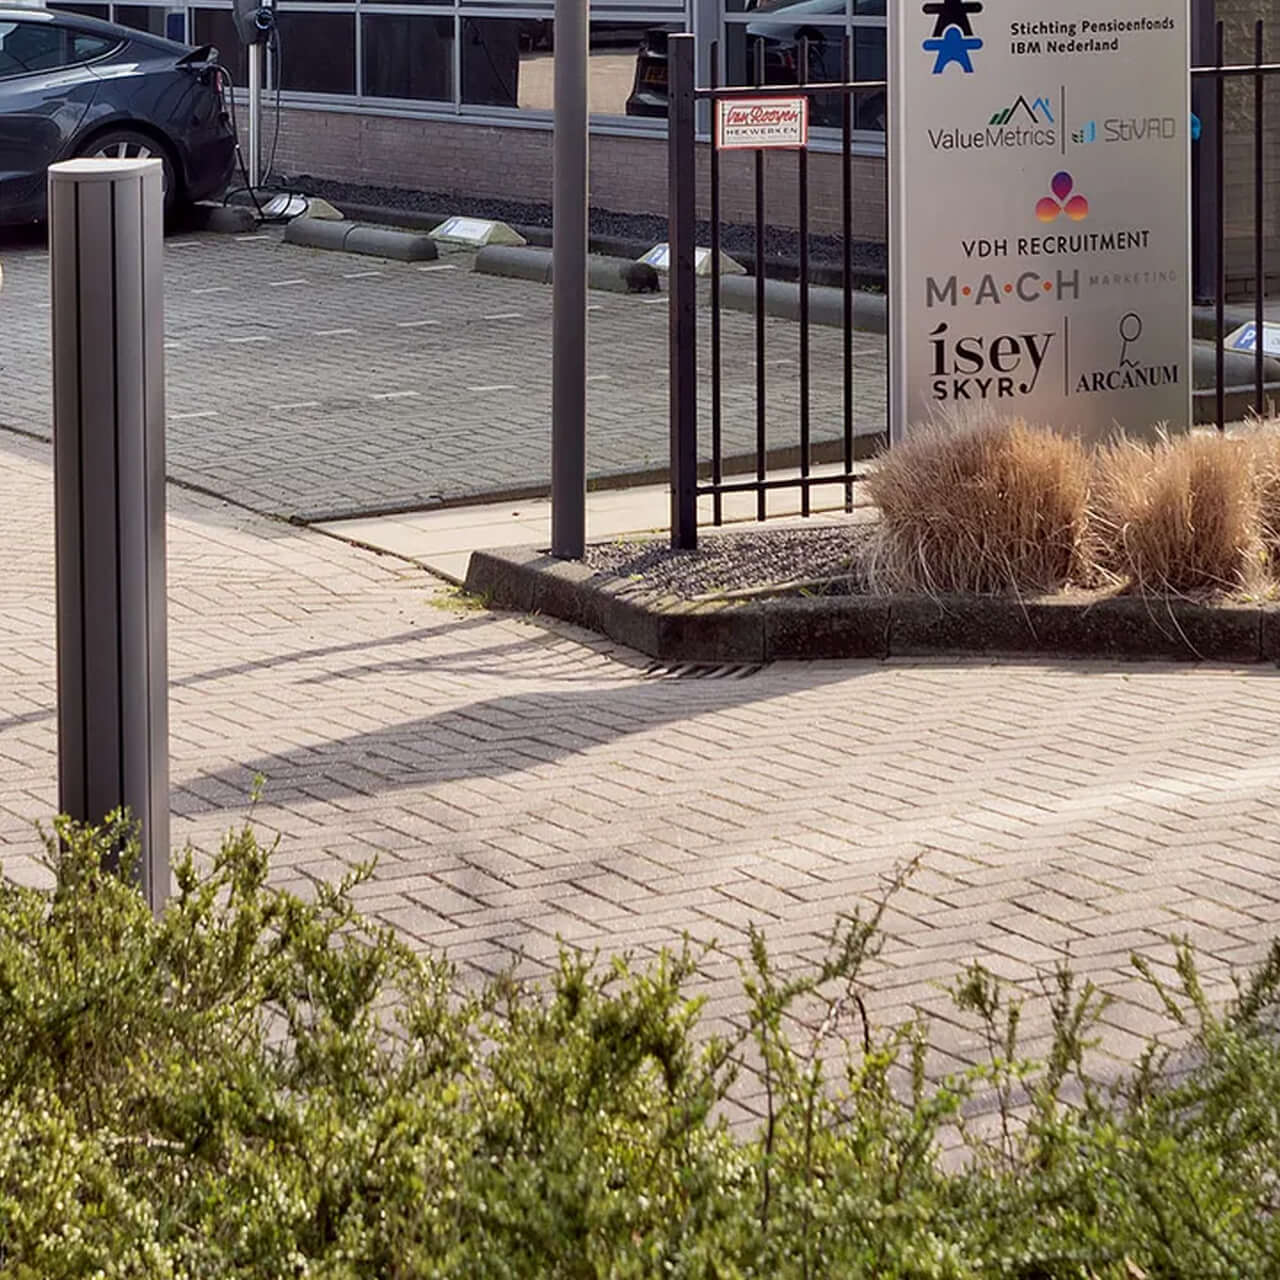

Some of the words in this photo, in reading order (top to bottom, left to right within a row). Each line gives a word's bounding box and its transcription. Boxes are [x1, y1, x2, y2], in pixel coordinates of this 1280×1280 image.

[1010, 21, 1076, 37] Stichting
[1082, 17, 1174, 33] Pensioenfonds
[1011, 42, 1041, 54] IBM
[1047, 38, 1118, 53] Nederland
[928, 126, 1055, 150] ValueMetrics
[962, 239, 1008, 257] VDH
[1018, 230, 1150, 256] RECRUITMENT
[933, 377, 1014, 401] SKYR
[1076, 365, 1178, 393] ARCANUM
